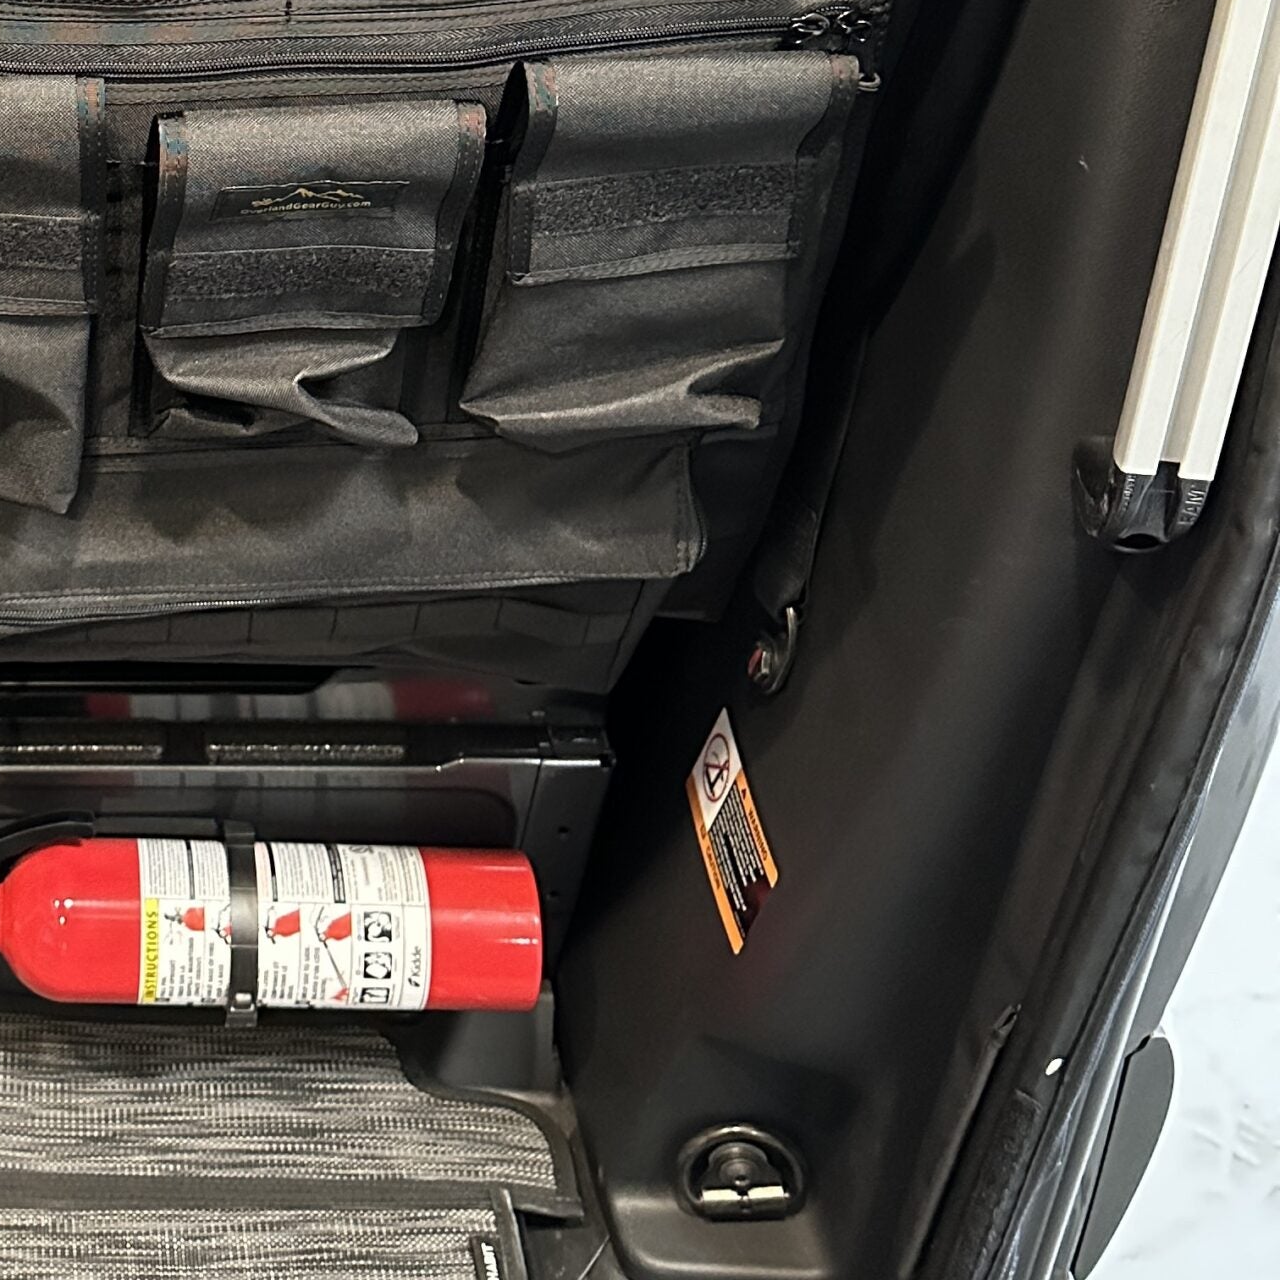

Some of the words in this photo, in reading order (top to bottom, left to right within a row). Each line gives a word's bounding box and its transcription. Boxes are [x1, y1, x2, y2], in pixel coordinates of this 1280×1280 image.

[240, 200, 372, 215] OverlandGearGuy.com
[748, 808, 768, 862] WARNING
[705, 845, 721, 890] CAUTION
[145, 910, 158, 998] INSTRUCTIONS
[410, 946, 422, 977] Kidde
